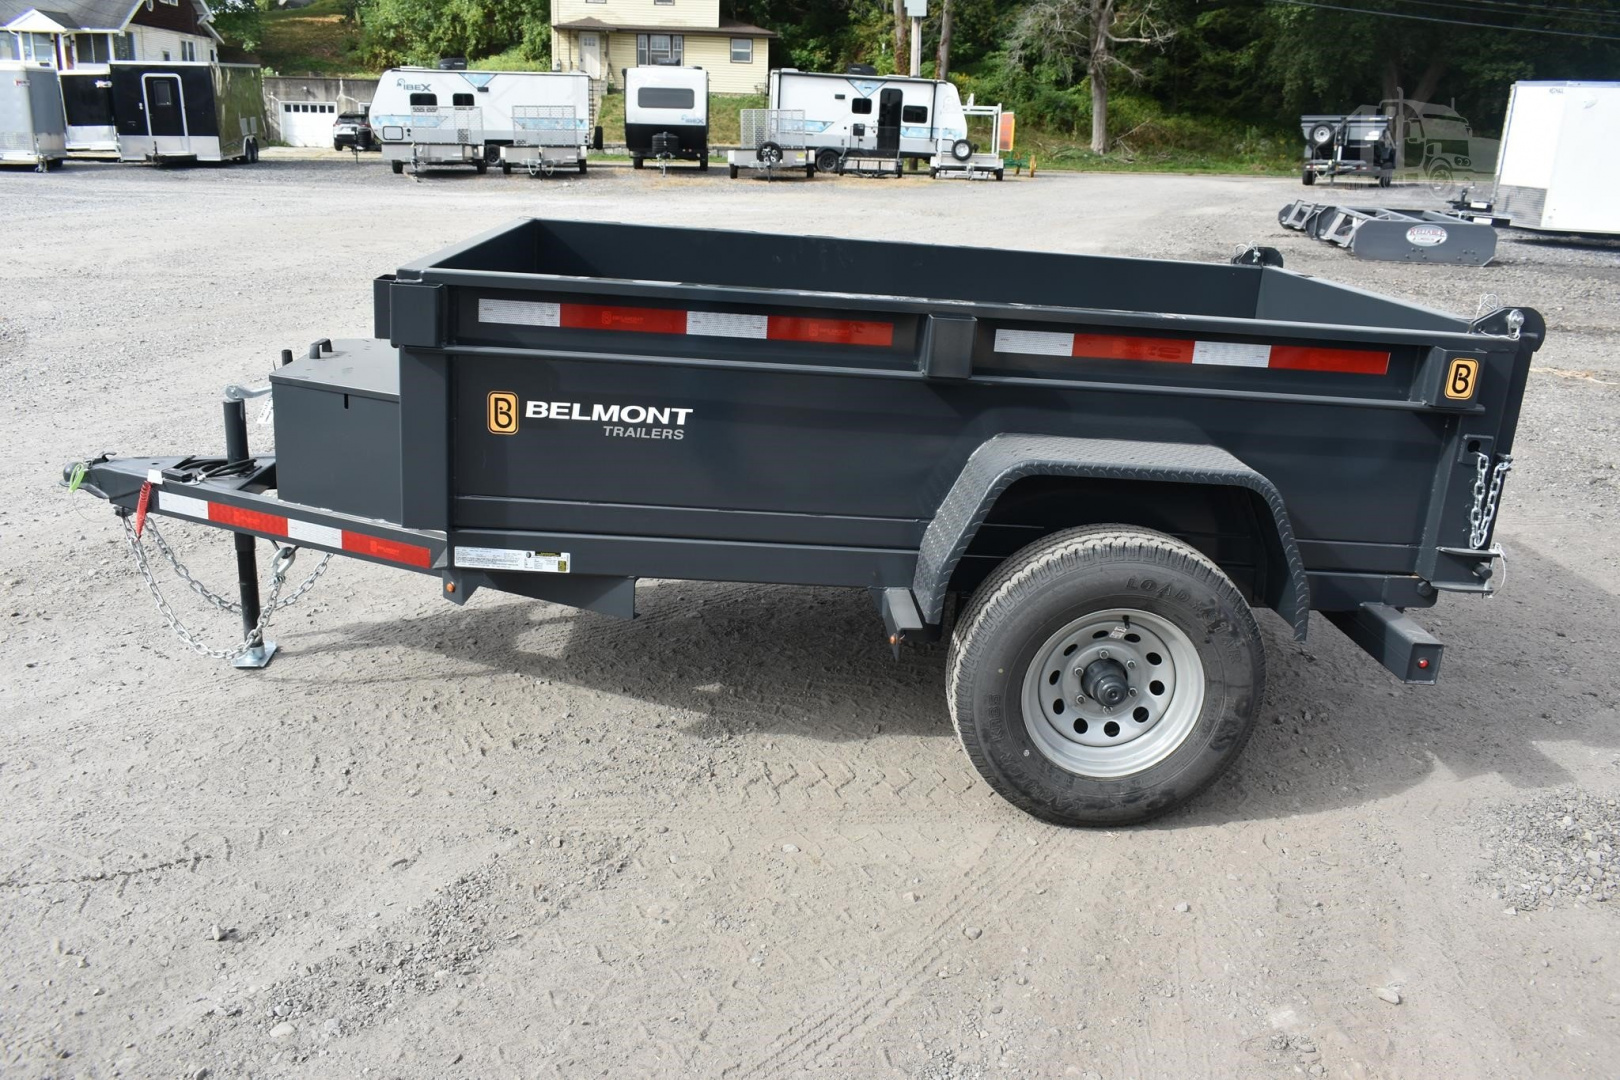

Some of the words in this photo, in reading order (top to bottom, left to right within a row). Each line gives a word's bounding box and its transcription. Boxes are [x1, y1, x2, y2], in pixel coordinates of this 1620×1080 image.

[404, 84, 431, 92] IBEX
[1409, 228, 1445, 237] RELIABLE
[1450, 362, 1473, 396] B
[525, 400, 693, 425] BELMONT
[603, 425, 685, 440] TRAILERS
